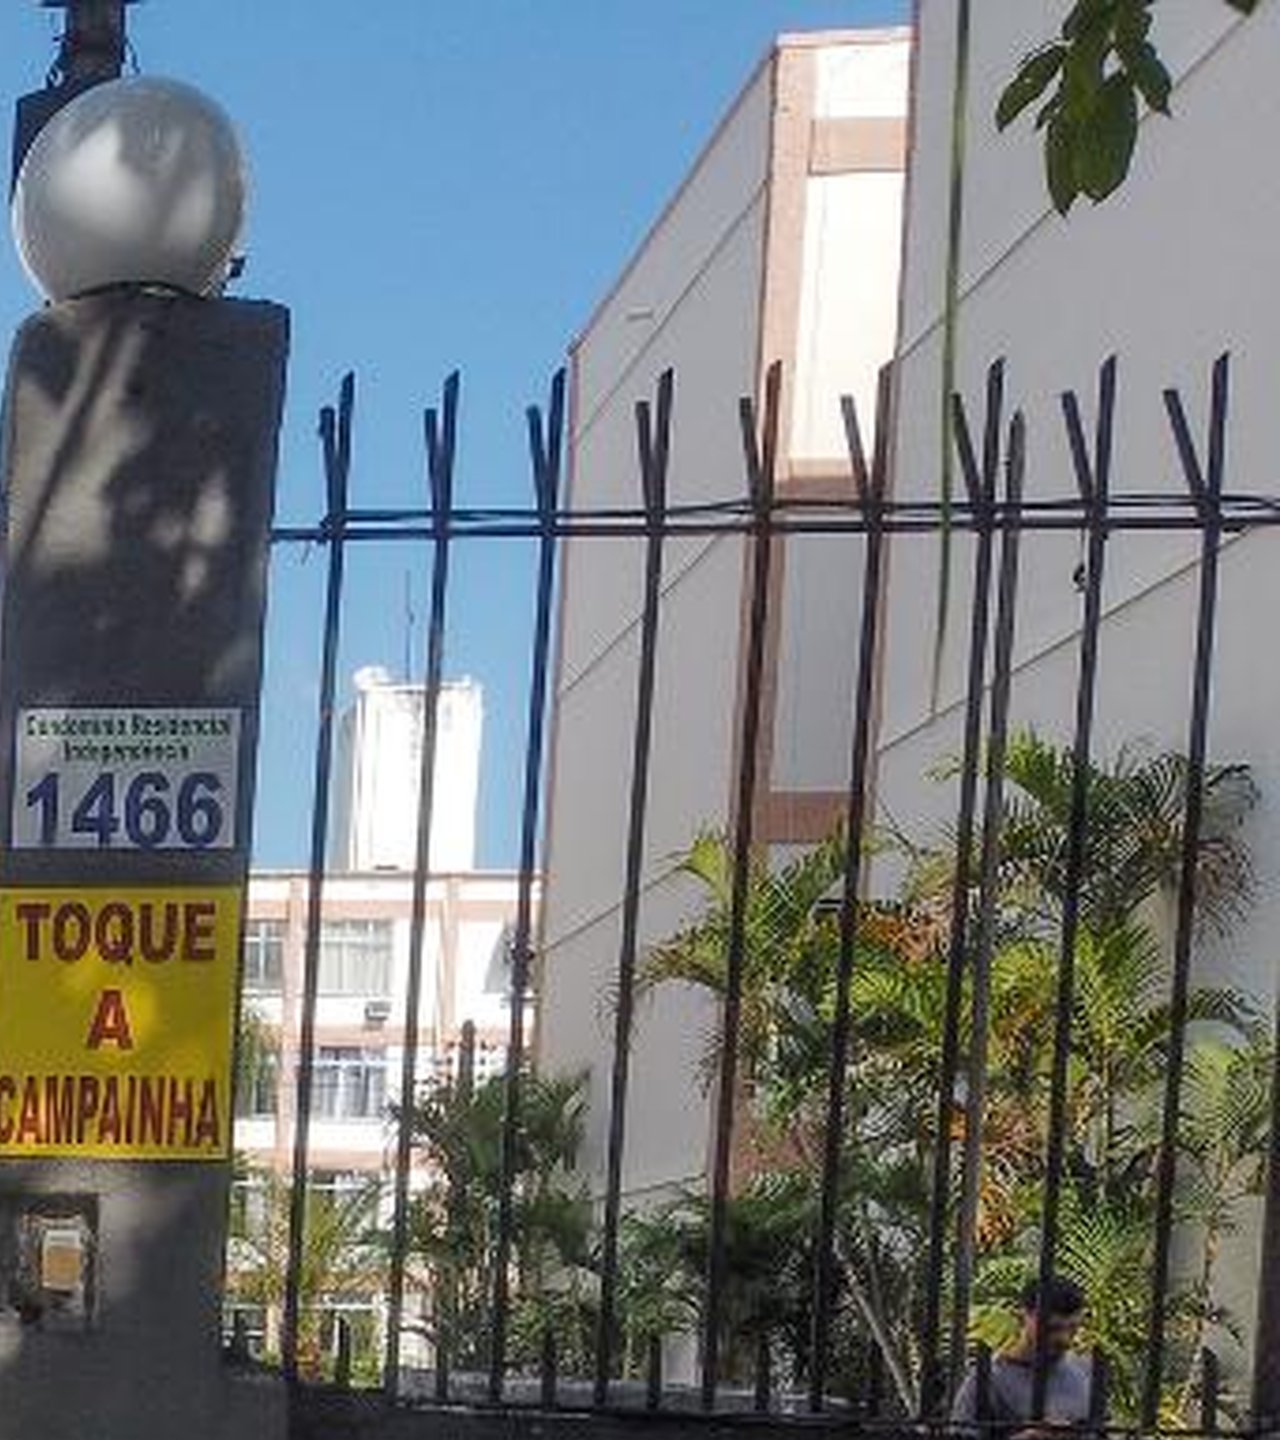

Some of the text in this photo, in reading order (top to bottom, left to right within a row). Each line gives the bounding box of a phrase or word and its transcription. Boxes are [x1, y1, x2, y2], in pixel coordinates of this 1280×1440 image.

[26, 772, 223, 847] 1466
[16, 902, 217, 964] TOQUE
[87, 989, 133, 1051] A
